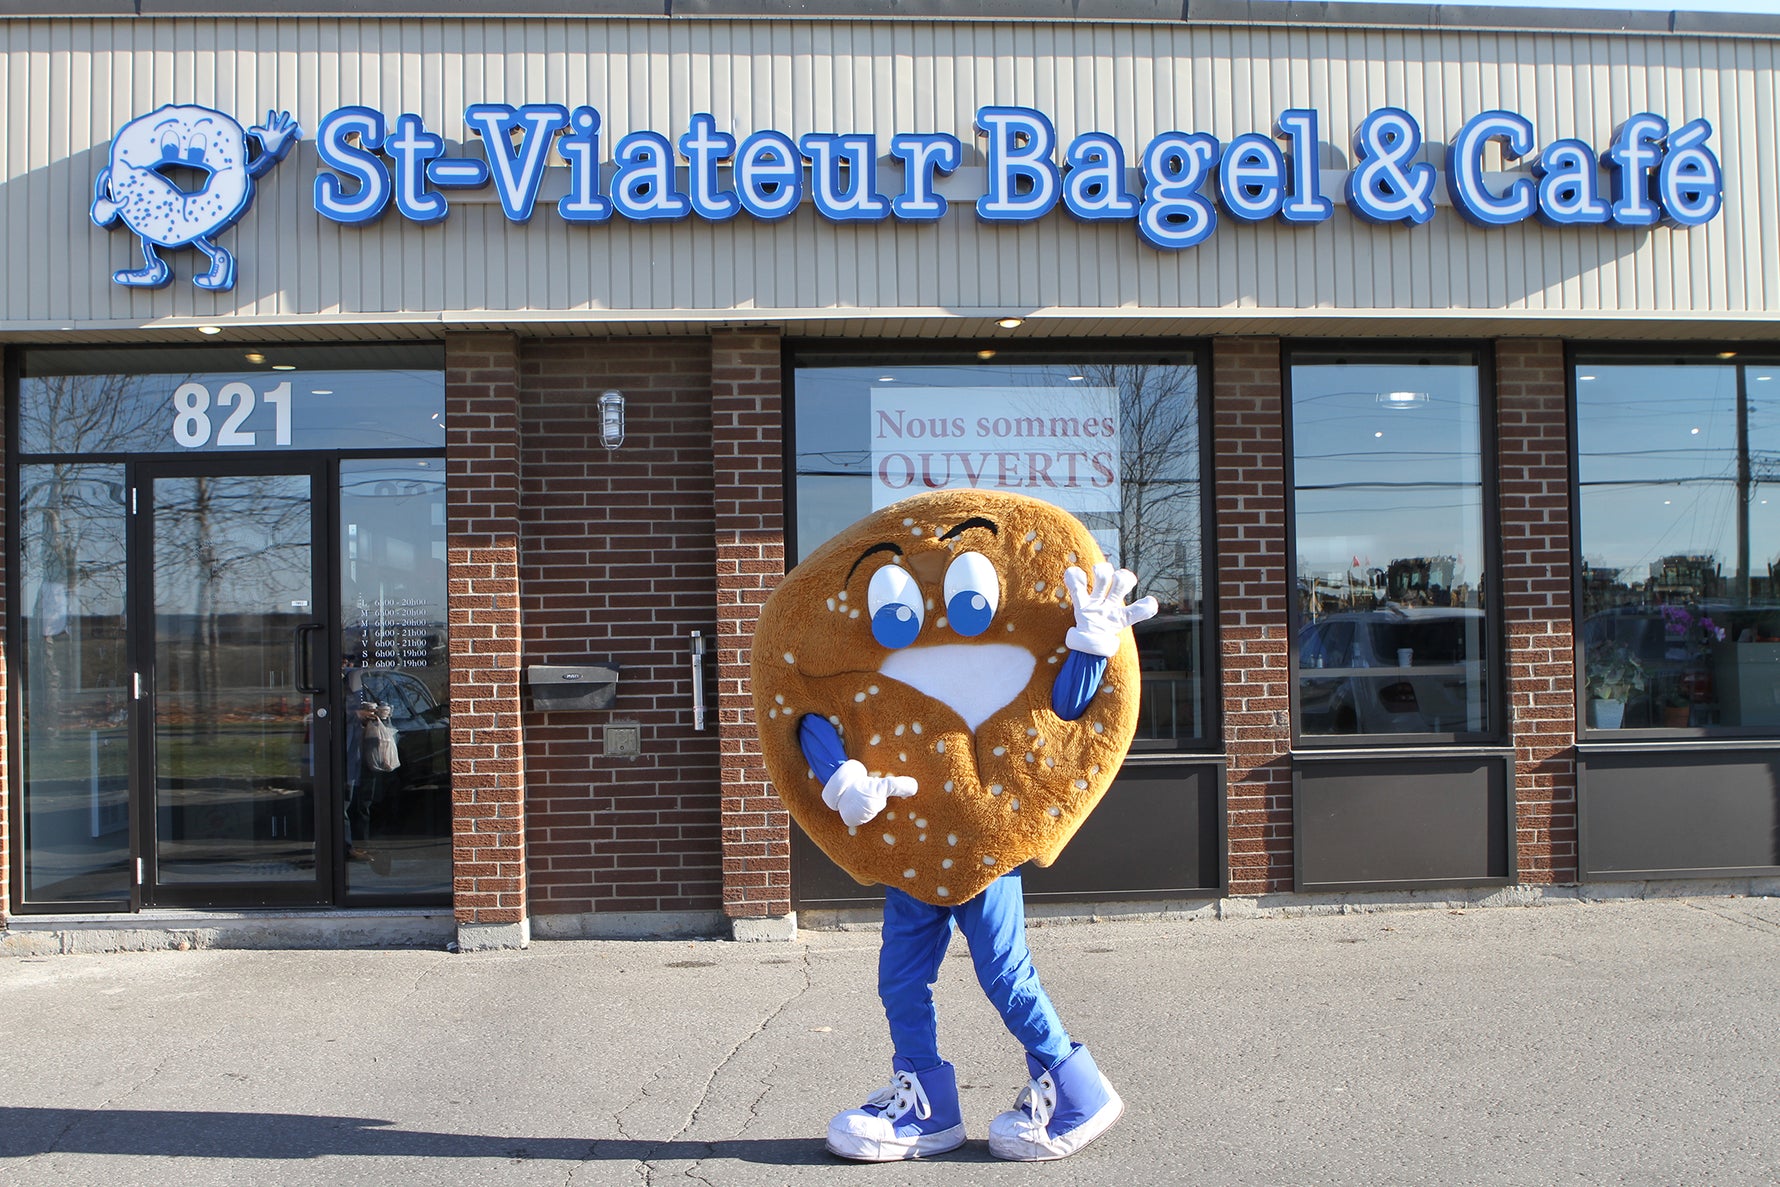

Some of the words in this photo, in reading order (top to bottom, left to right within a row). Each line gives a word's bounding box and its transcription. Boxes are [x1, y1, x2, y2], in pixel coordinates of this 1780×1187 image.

[313, 103, 962, 224] St-Viateur
[972, 106, 1335, 251] Bagel
[1345, 107, 1437, 226] &
[1445, 110, 1723, 228] Café
[173, 381, 292, 448] 821
[876, 409, 966, 439] Nous
[976, 416, 1115, 438] sommes
[878, 451, 1115, 490] OUVERTS
[361, 629, 368, 637] J
[401, 629, 427, 637] 21h00
[374, 639, 396, 648] 6h00
[401, 639, 427, 647] 21h00
[361, 650, 369, 658] S
[375, 649, 396, 657] 6h00
[402, 649, 427, 657] 19h00
[362, 660, 370, 668] D
[375, 660, 397, 668] 6h00
[403, 659, 428, 667] 19h00
